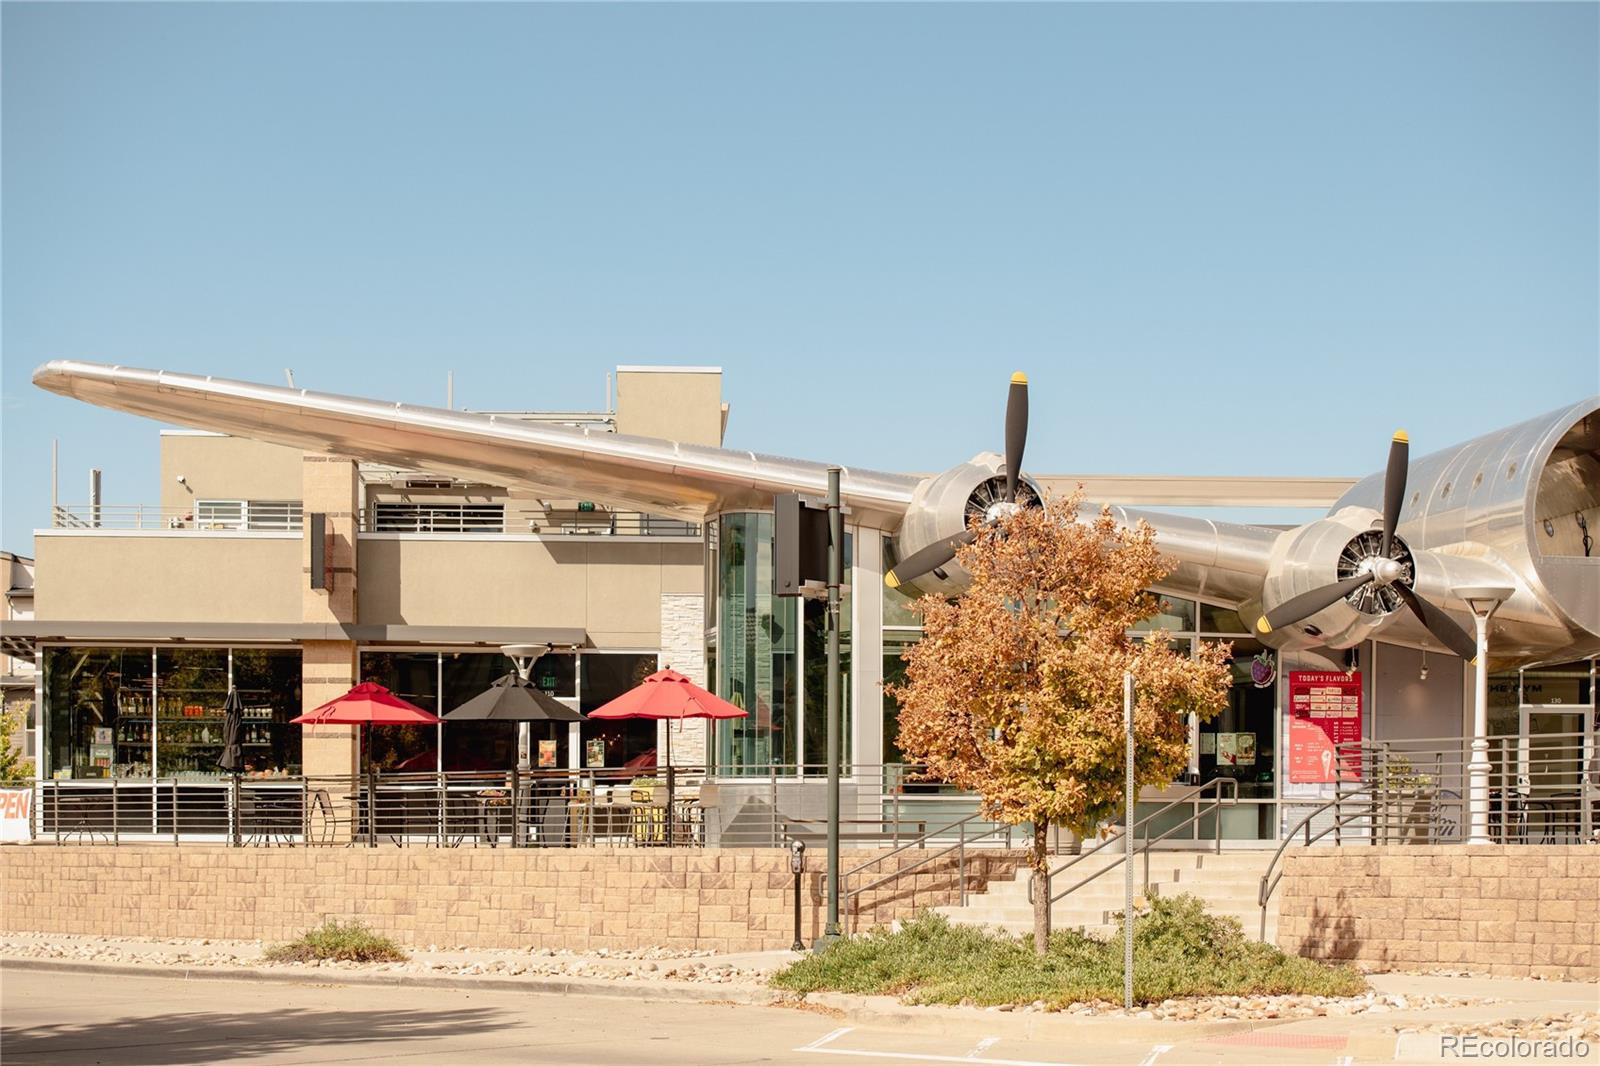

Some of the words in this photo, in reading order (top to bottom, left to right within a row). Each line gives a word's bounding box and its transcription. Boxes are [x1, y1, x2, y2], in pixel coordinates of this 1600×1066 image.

[543, 676, 555, 687] EXIT
[1298, 674, 1324, 682] TODAY'S
[1325, 674, 1353, 682] FLAVORS
